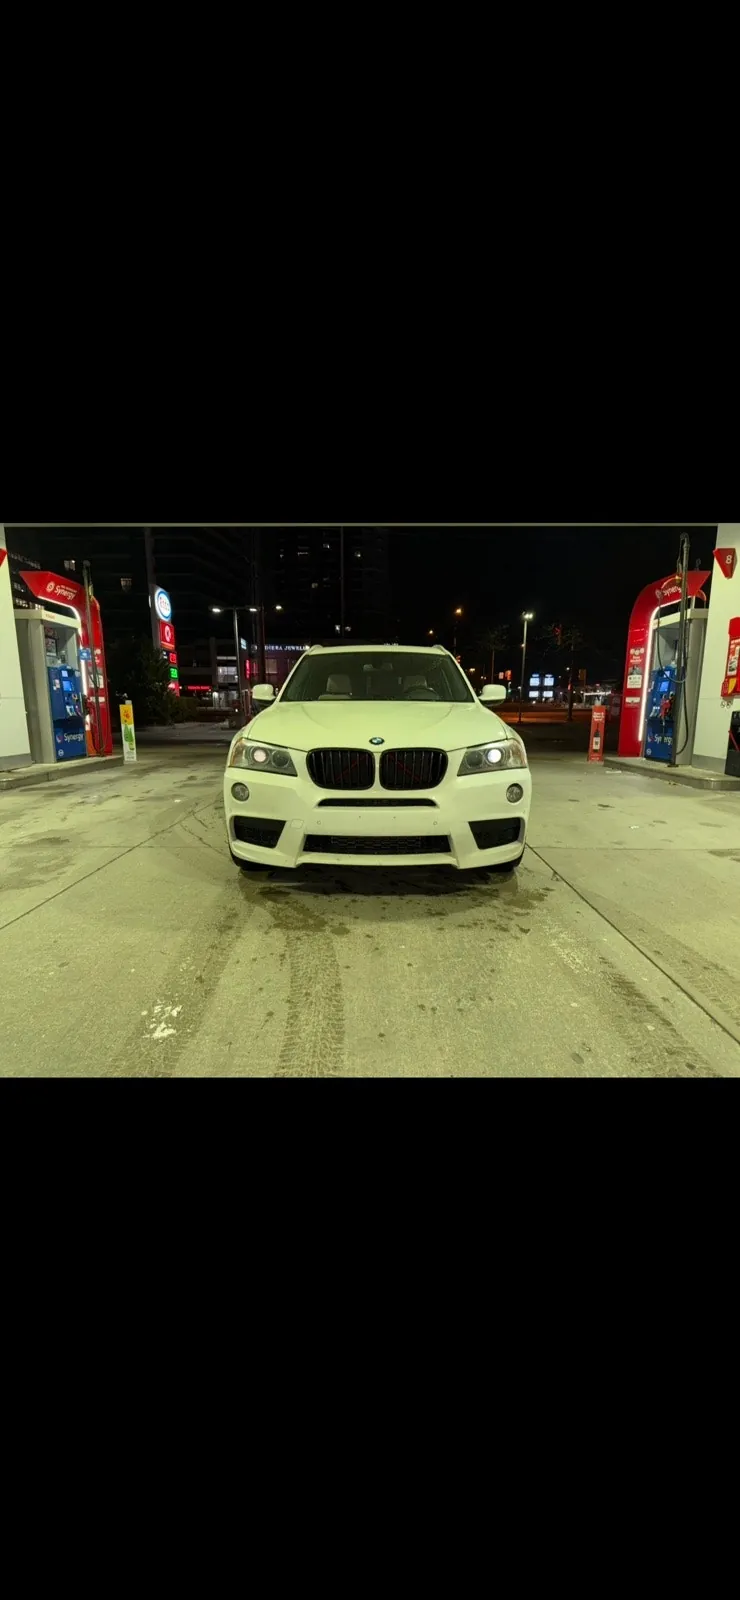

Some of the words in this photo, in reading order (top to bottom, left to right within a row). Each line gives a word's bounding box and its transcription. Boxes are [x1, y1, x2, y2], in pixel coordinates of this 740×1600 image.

[726, 555, 732, 564] 8
[54, 585, 76, 600] Synergy
[662, 586, 682, 597] Synerg
[63, 732, 84, 743] Synergy
